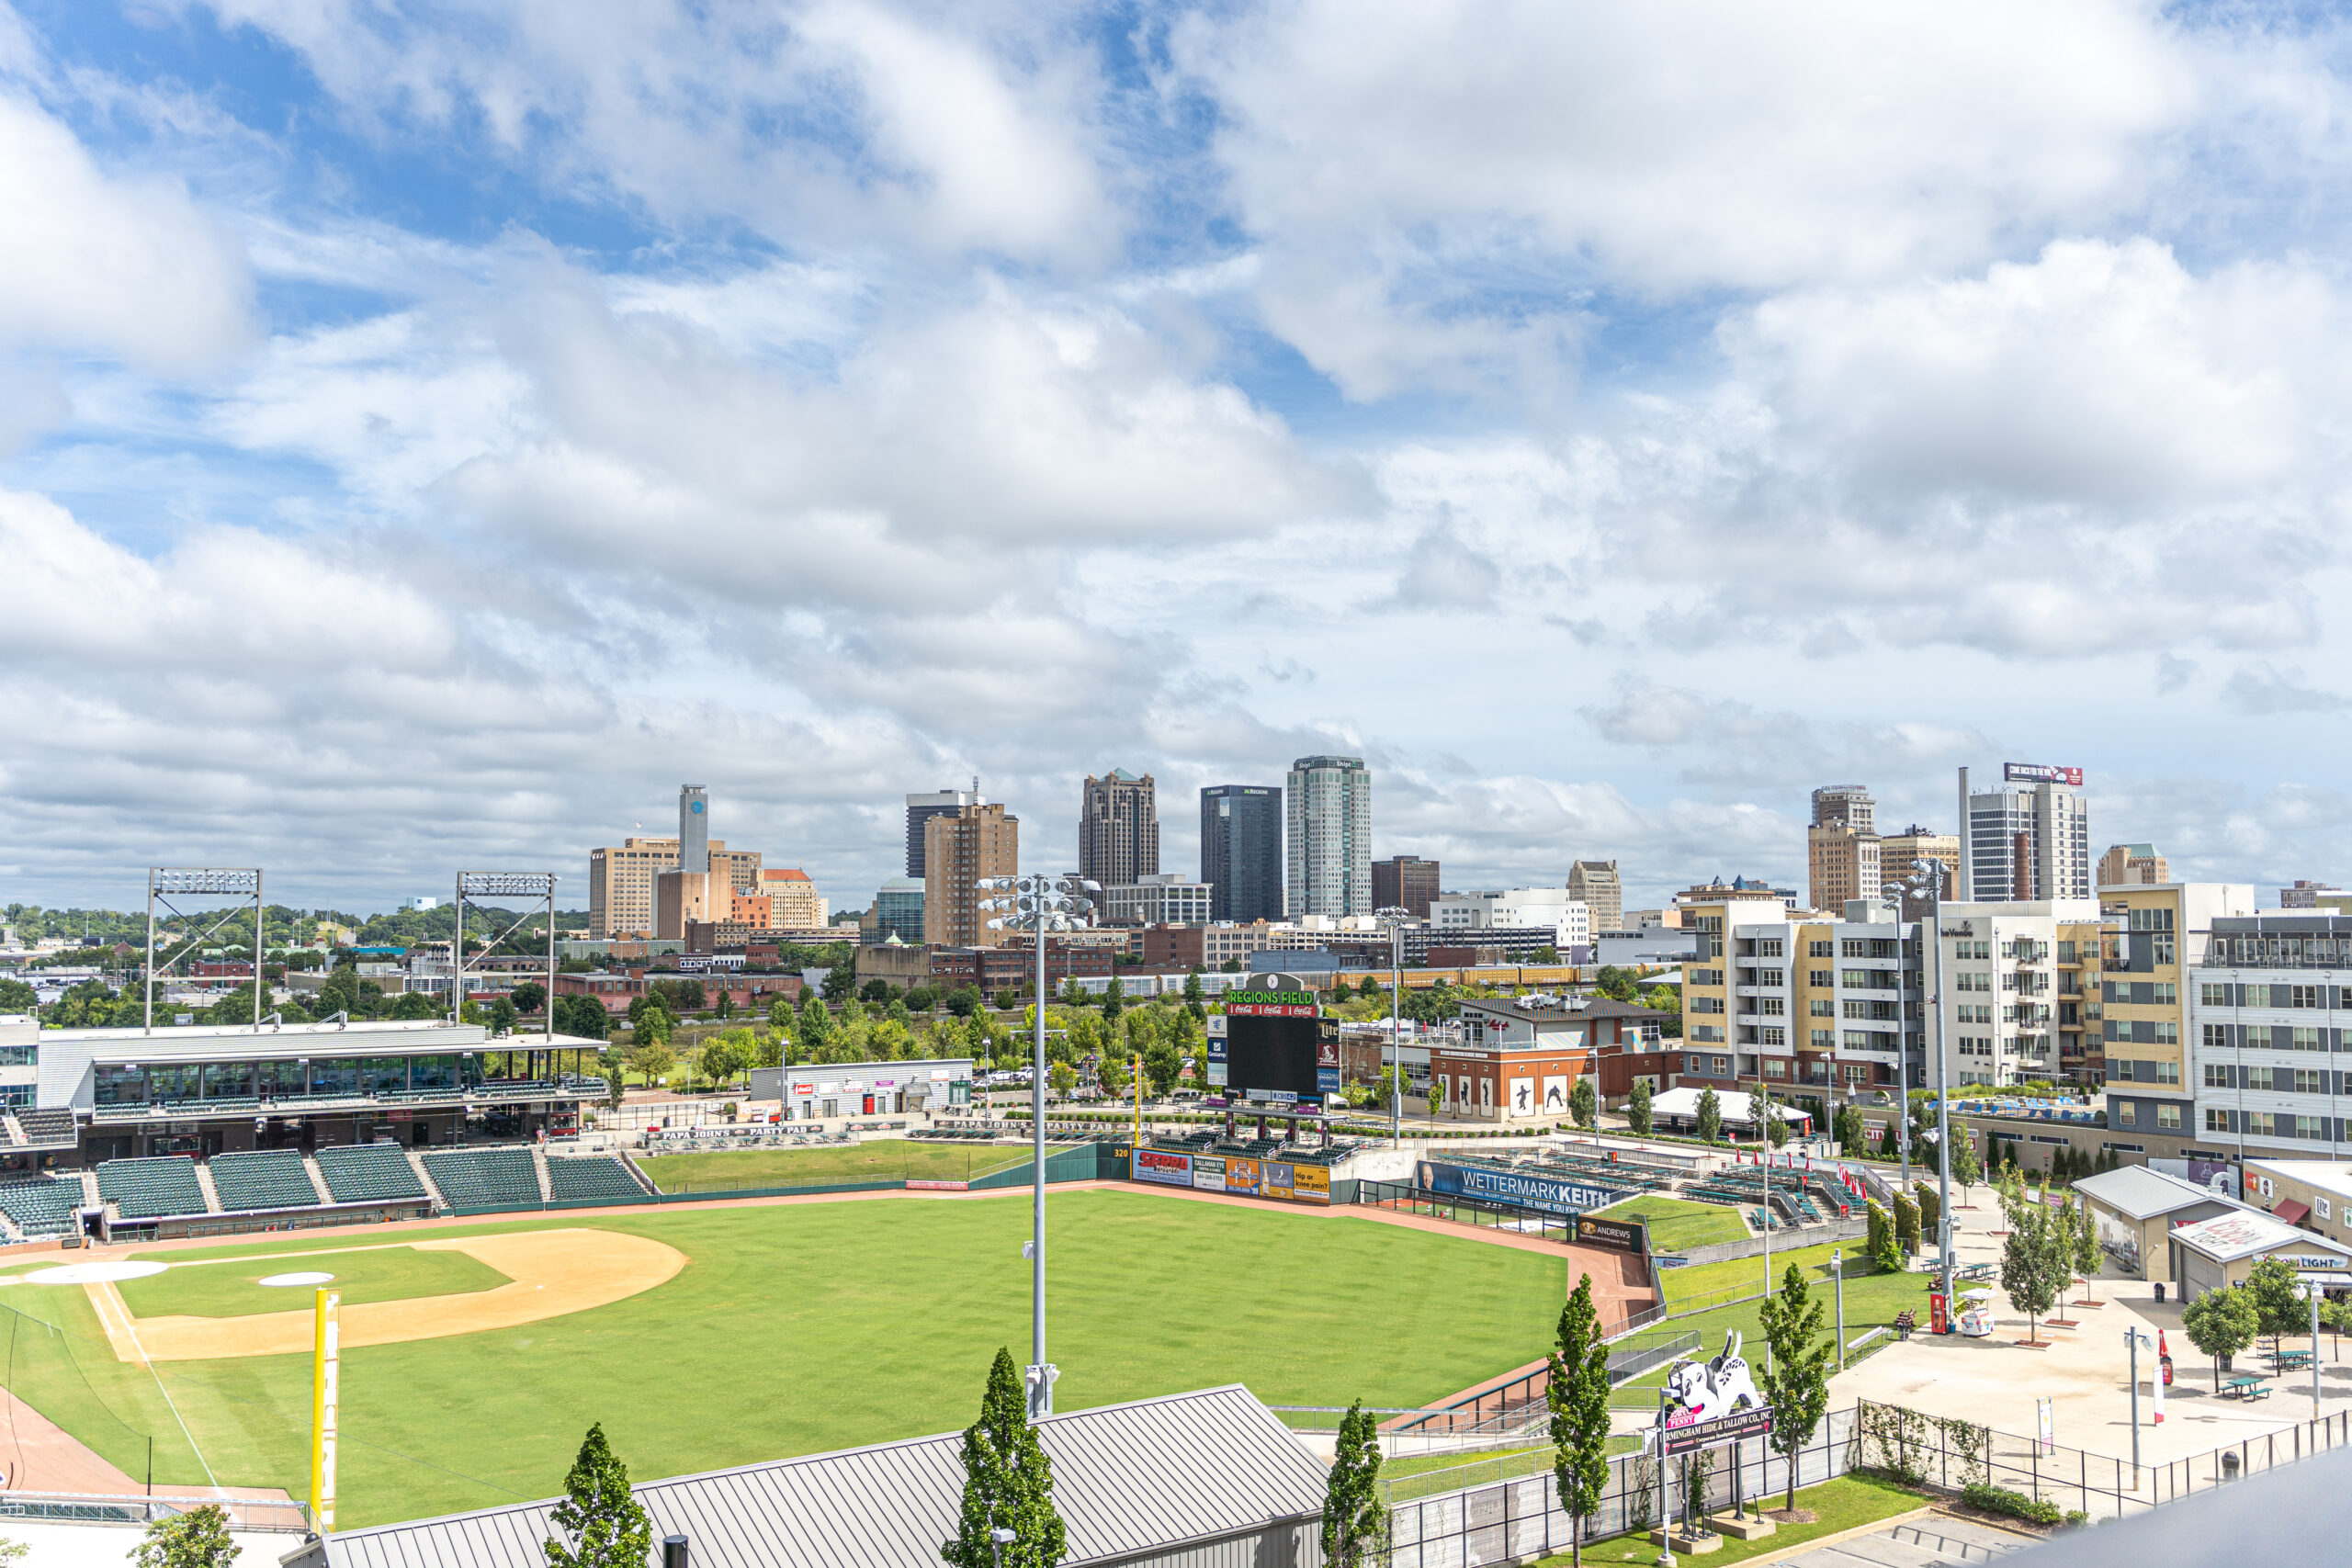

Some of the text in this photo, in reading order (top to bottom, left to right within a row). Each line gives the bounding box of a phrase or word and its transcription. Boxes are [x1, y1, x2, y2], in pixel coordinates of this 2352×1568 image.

[1940, 928, 1973, 937] heVenue
[1231, 991, 1313, 1005] REGIONS FIELD
[1321, 1025, 1338, 1038] Lite
[663, 1131, 690, 1140] PAPA
[693, 1130, 730, 1138] JOHN'S
[750, 1127, 783, 1136] PARTY
[1114, 1149, 1128, 1157] 320
[1138, 1152, 1187, 1170] SERRA
[1195, 1159, 1216, 1168] CALLAHAN
[1154, 1165, 1181, 1174] TOYOTA
[1296, 1172, 1305, 1181] Hip
[1463, 1171, 1559, 1200] WETTERMARK
[1559, 1185, 1610, 1208] KEITH
[1463, 1189, 1484, 1197] PERSONAL
[1501, 1195, 1521, 1203] LAWYERS
[1524, 1199, 1534, 1208] THE
[1535, 1200, 1551, 1210] NAME
[1553, 1203, 1564, 1213] YOU
[2317, 1198, 2327, 1215] Lite
[1597, 1226, 1630, 1239] ANDREWS
[2301, 1258, 2334, 1268] LIGHT
[1660, 1425, 1701, 1442] RMINGHAM
[1702, 1422, 1717, 1435] HIDE
[1724, 1417, 1748, 1429] TALLOW
[1761, 1411, 1773, 1421] INC.
[1670, 1416, 1694, 1428] PENNY
